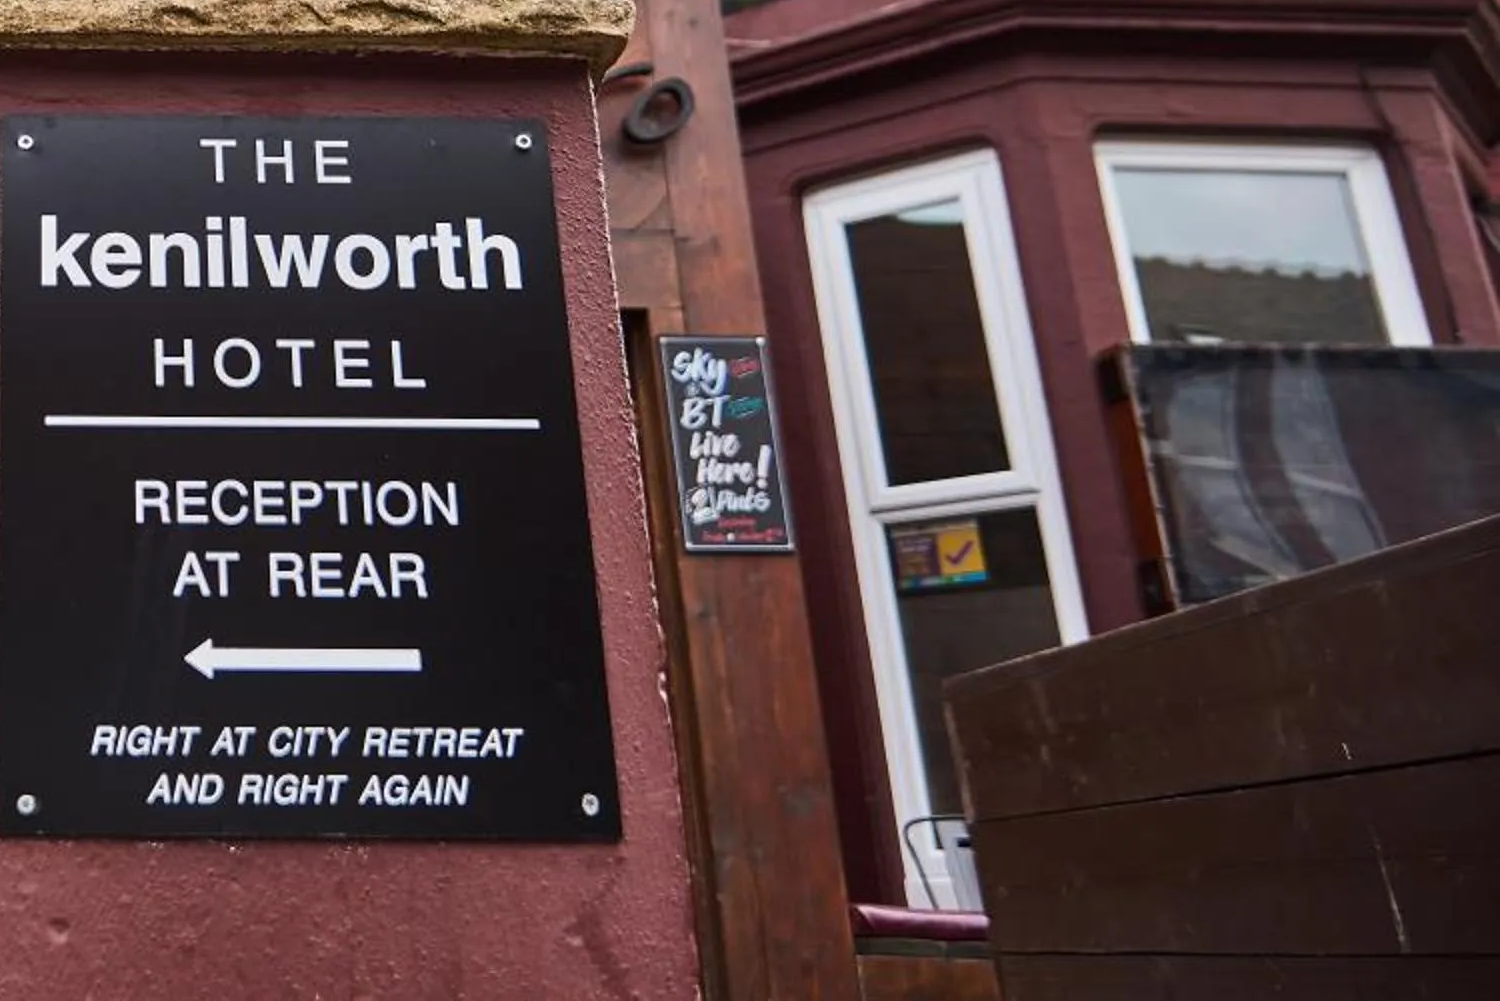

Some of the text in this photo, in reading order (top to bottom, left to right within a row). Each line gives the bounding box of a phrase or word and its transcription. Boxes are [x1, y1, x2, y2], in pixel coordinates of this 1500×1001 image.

[199, 138, 352, 184] THE
[40, 214, 523, 290] kenilworth
[154, 337, 427, 388] HOTEL
[680, 394, 731, 429] BT
[690, 430, 741, 459] Live
[135, 479, 459, 526] RECEPTION
[172, 551, 428, 598] AT REAR
[90, 724, 524, 758] RIGHT AT CITY RETREAT
[146, 773, 470, 806] AND RIGHT AGAIN
